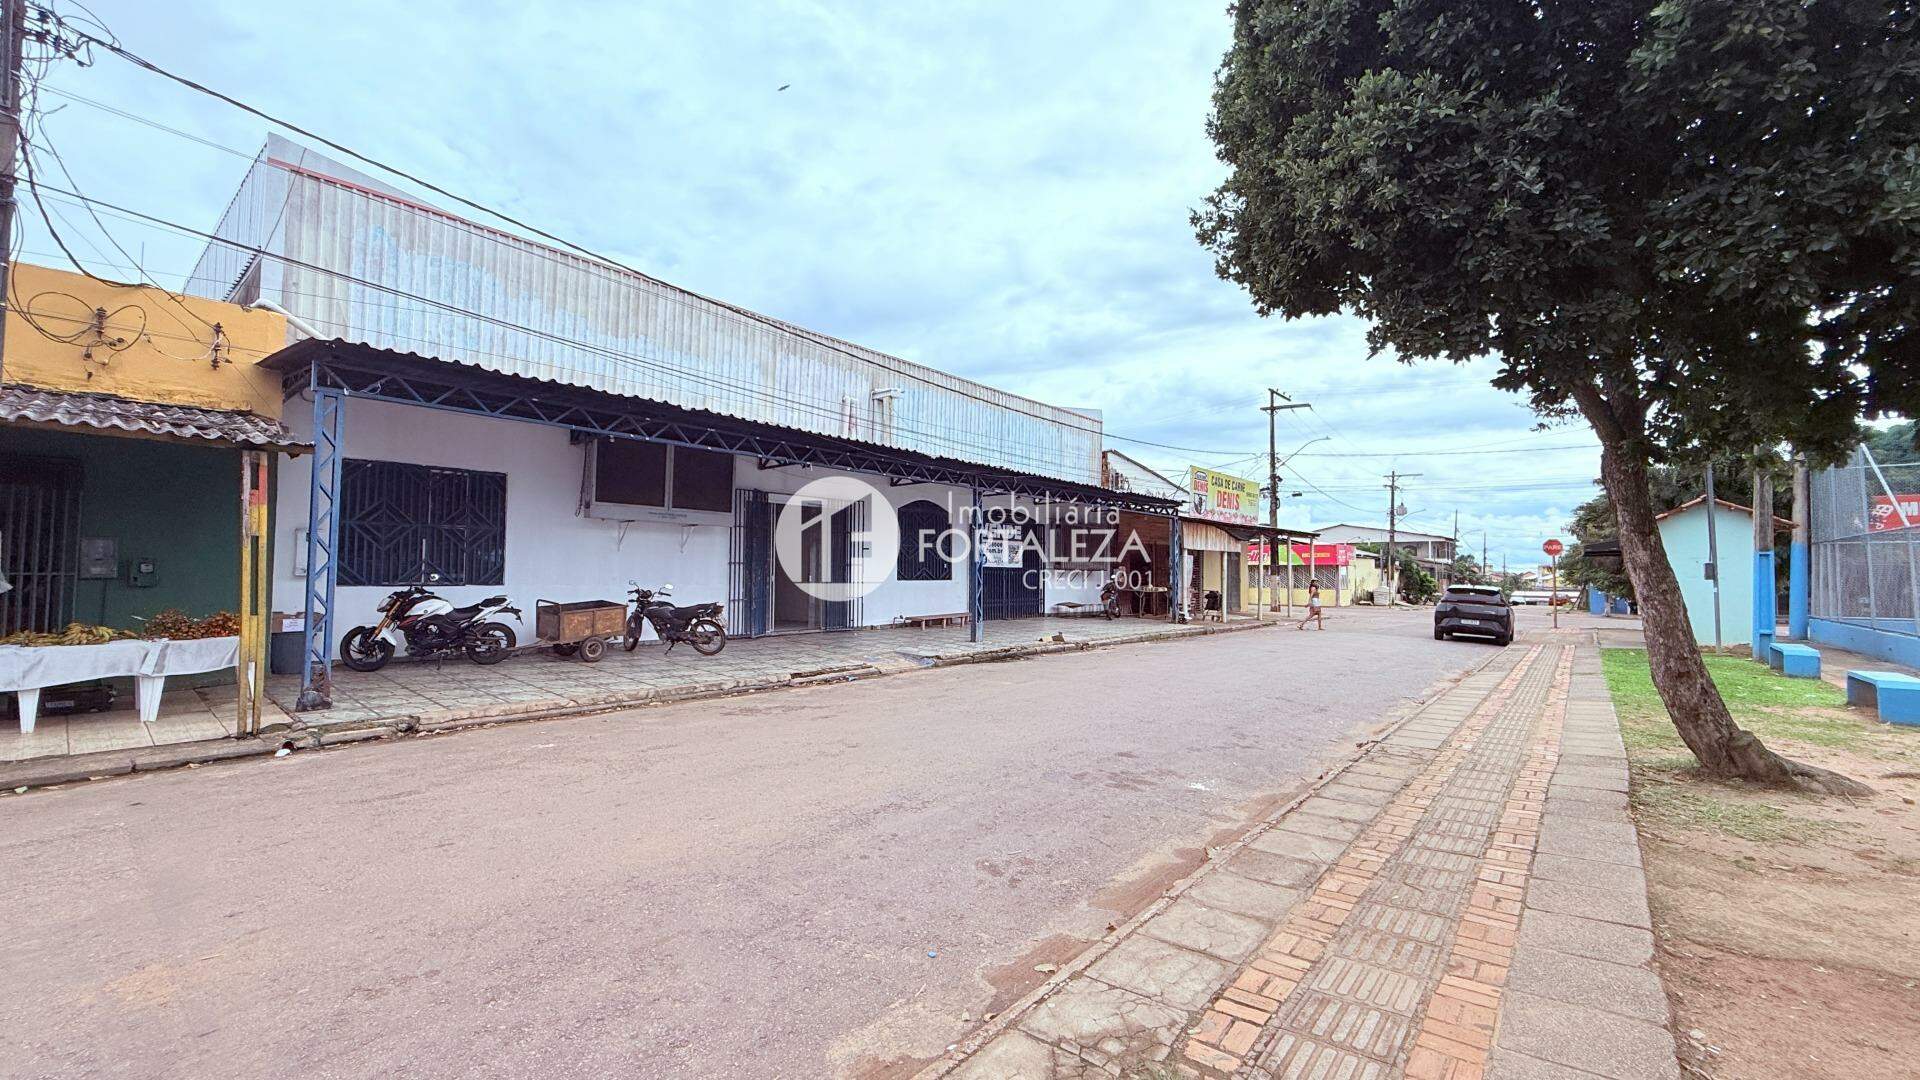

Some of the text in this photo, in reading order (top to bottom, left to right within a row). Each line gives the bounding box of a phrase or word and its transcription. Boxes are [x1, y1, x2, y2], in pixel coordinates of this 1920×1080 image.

[1194, 480, 1208, 493] DENIS
[1211, 475, 1223, 488] CASA
[1225, 479, 1230, 489] DE
[1232, 481, 1246, 492] CARNE
[1217, 490, 1239, 510] DENIS
